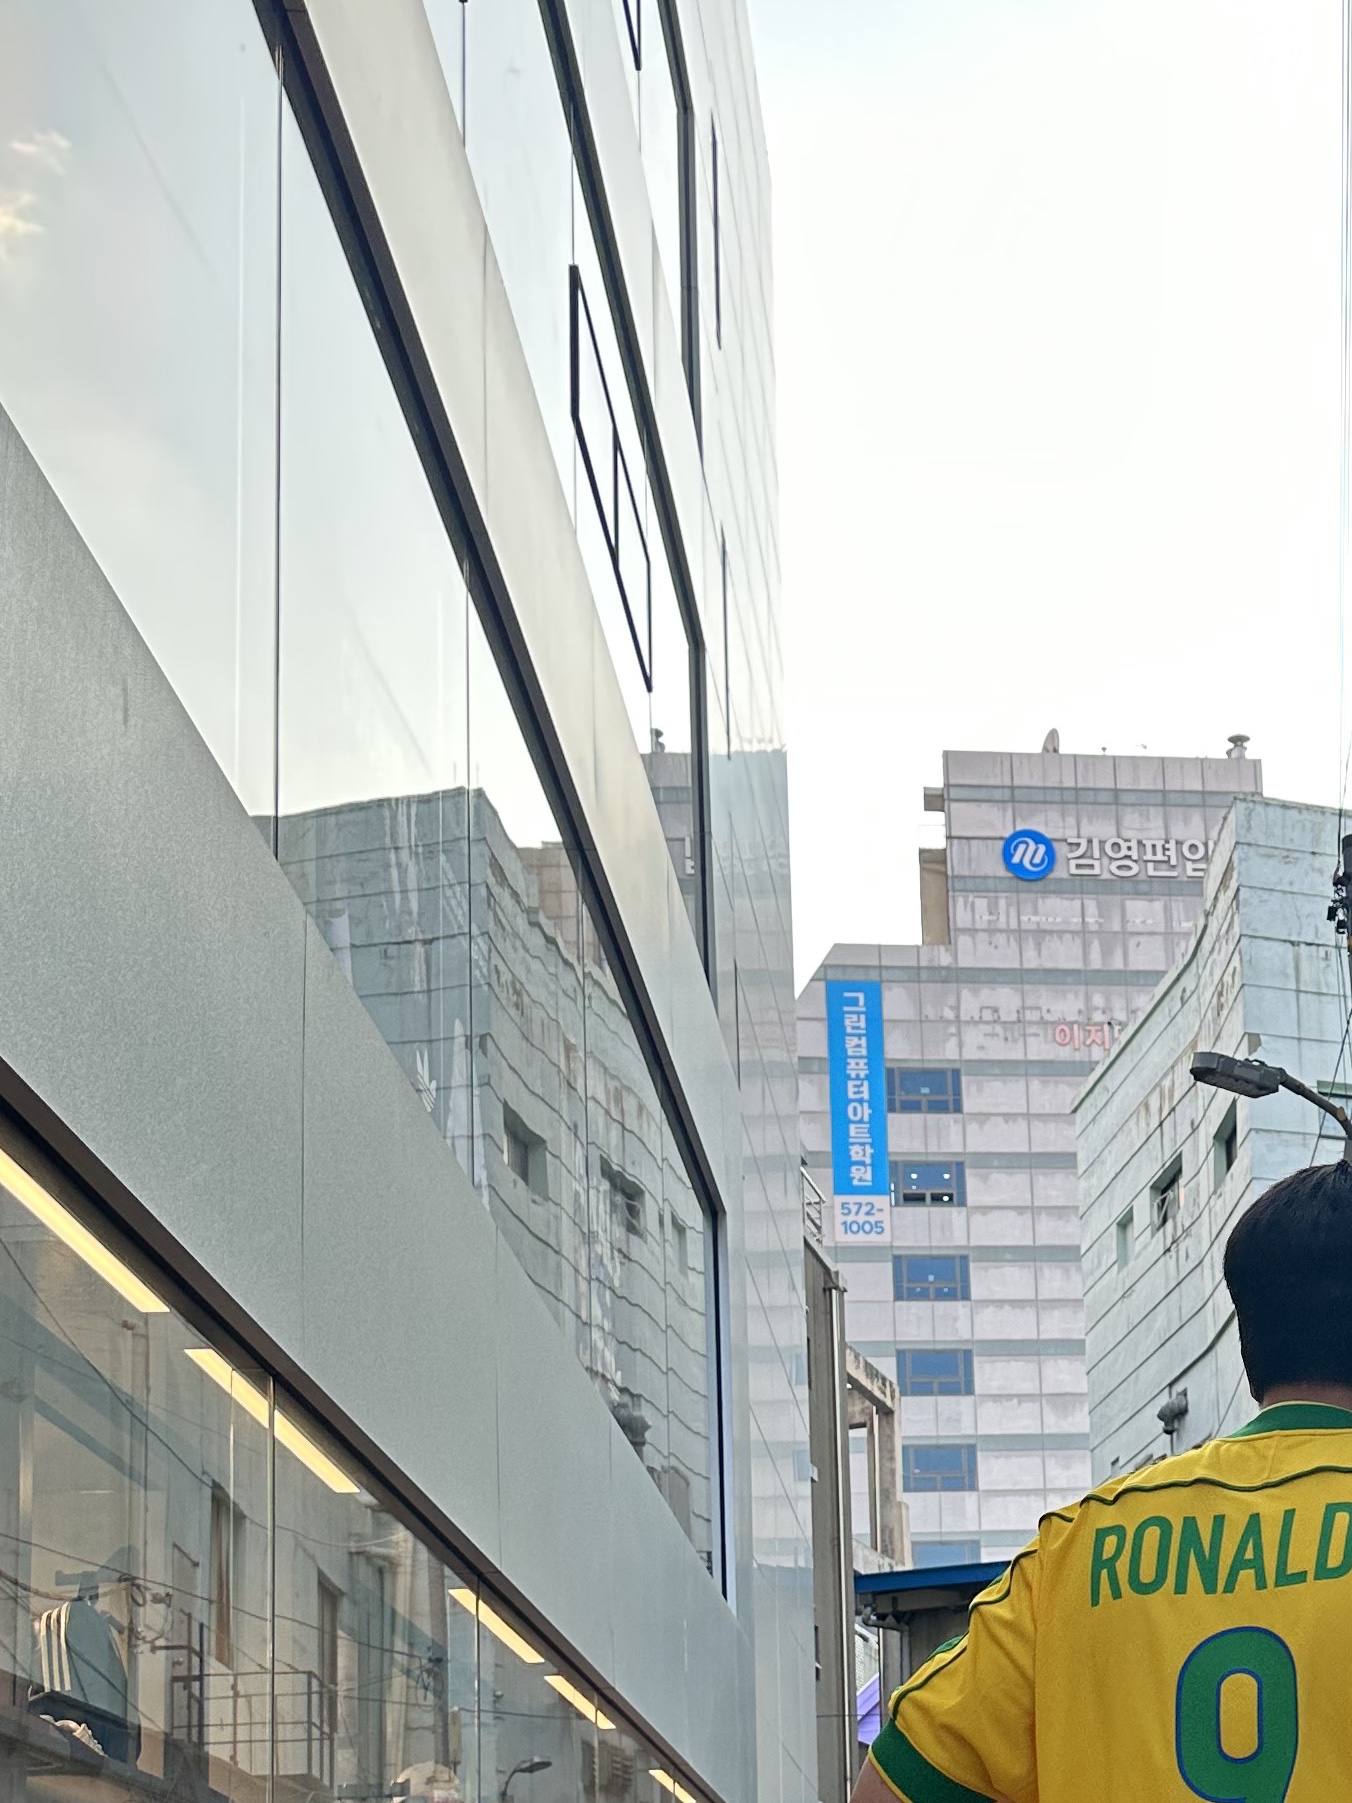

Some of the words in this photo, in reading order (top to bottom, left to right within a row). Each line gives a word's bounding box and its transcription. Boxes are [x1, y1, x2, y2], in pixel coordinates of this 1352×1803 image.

[1055, 1022, 1121, 1050] 이지
[843, 991, 874, 1186] 그린컴퓨터아트학원
[840, 1201, 884, 1216] 572-
[841, 1220, 885, 1235] 1005
